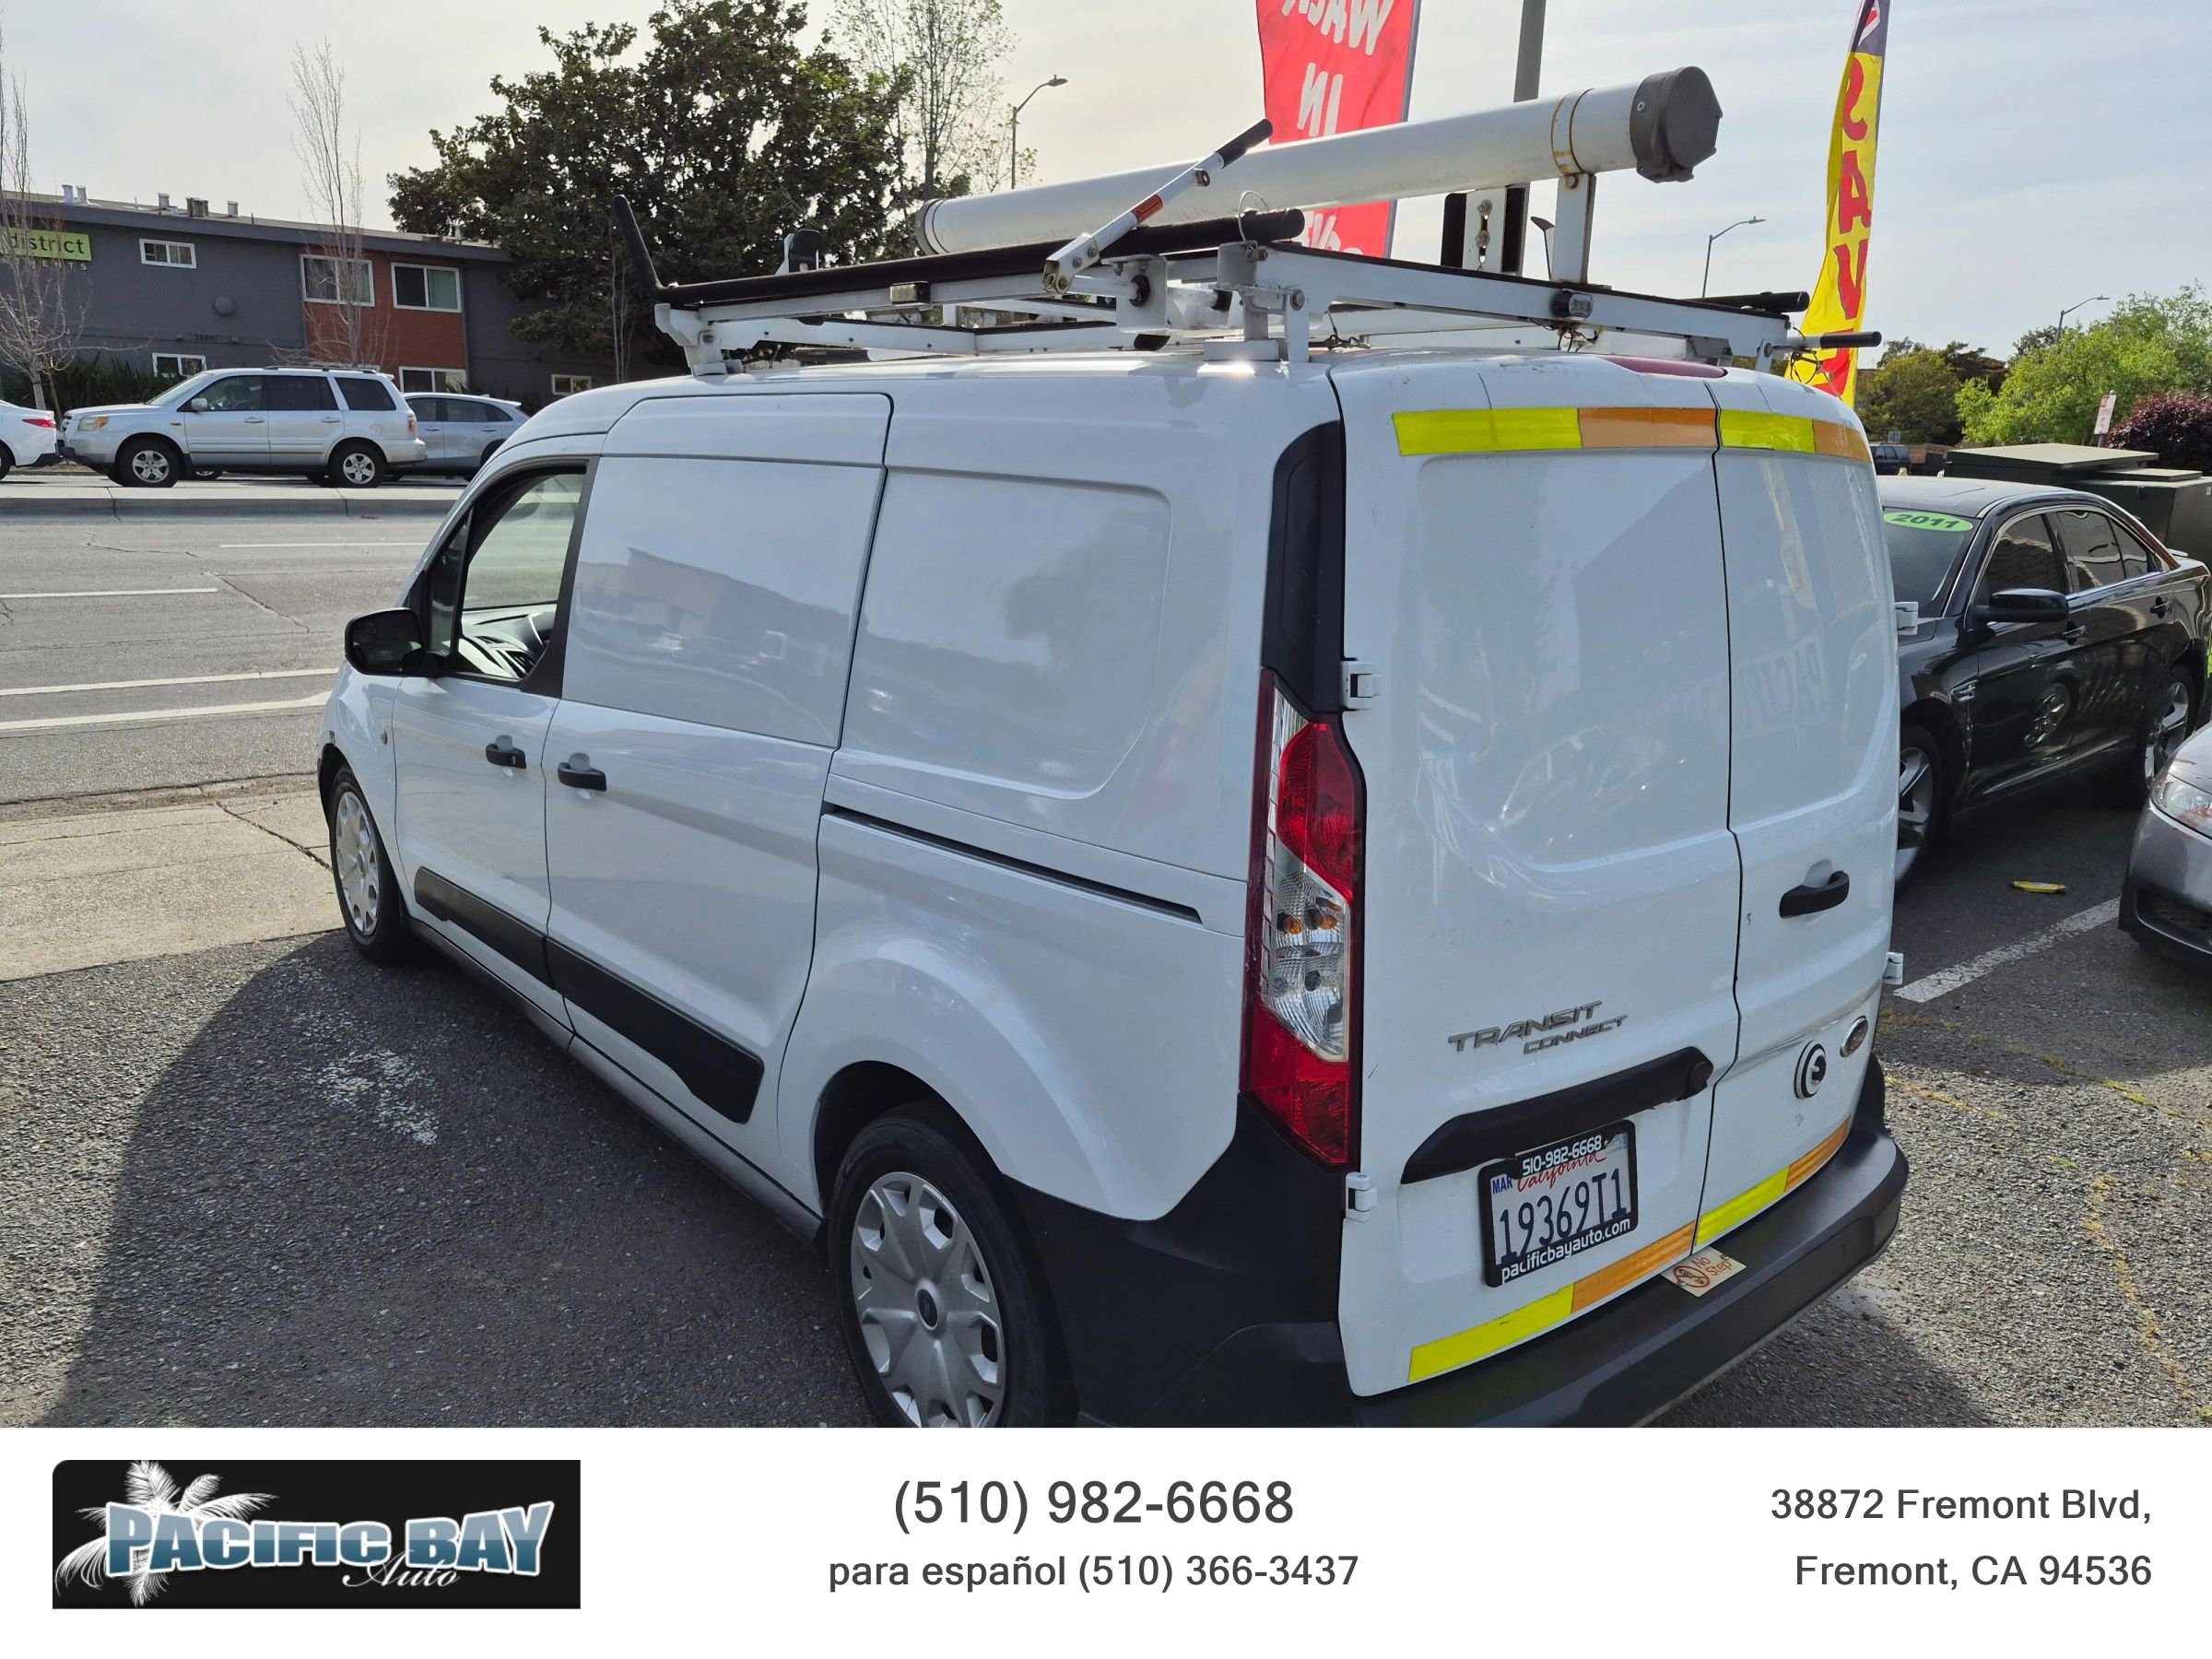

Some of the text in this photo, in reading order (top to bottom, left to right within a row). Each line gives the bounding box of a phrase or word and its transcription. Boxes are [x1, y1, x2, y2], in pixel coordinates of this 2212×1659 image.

[1892, 513, 1959, 529] 2011
[1448, 1000, 1603, 1053] TRANSIT
[1524, 1015, 1629, 1054] CONNECT
[1522, 1135, 1603, 1177] 510-982-6668
[1491, 1176, 1513, 1195] MAR
[1499, 1168, 1628, 1265] 19369T1
[1500, 1218, 1630, 1285] pacificbayauto.com
[1691, 1256, 1712, 1269] No
[1705, 1260, 1732, 1277] Step
